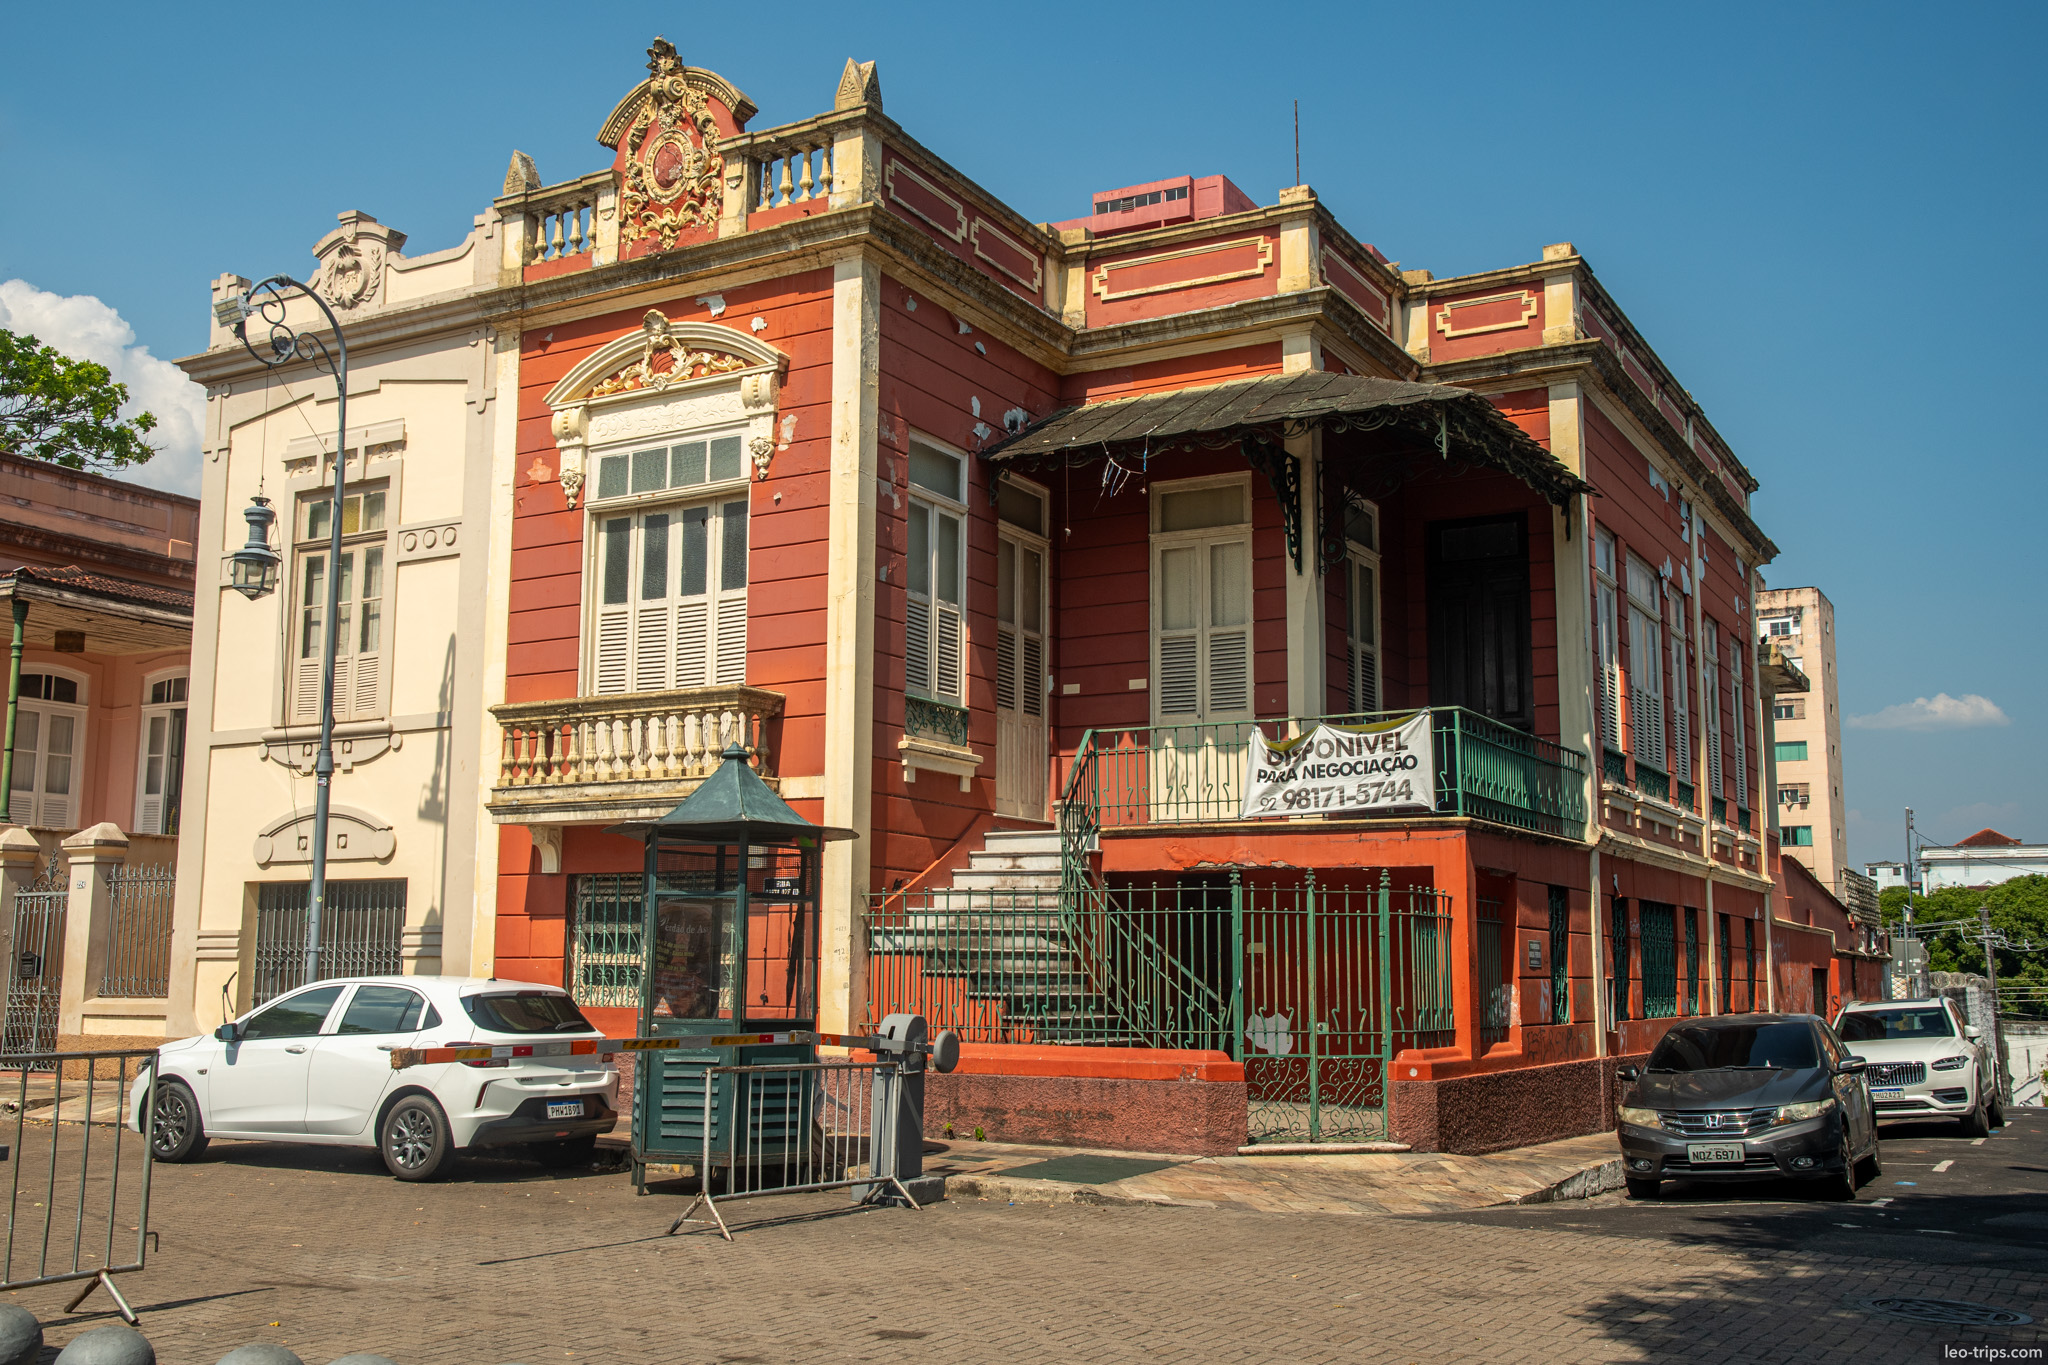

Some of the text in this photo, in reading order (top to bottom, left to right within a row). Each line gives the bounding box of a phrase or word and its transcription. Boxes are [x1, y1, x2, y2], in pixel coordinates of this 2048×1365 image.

[1267, 731, 1408, 766] DISPONÍVEL
[1257, 752, 1418, 783] PARA NEGOCIAÇÃO
[1260, 779, 1413, 812] 92 98171-5744
[551, 1105, 581, 1117] PHW1B91
